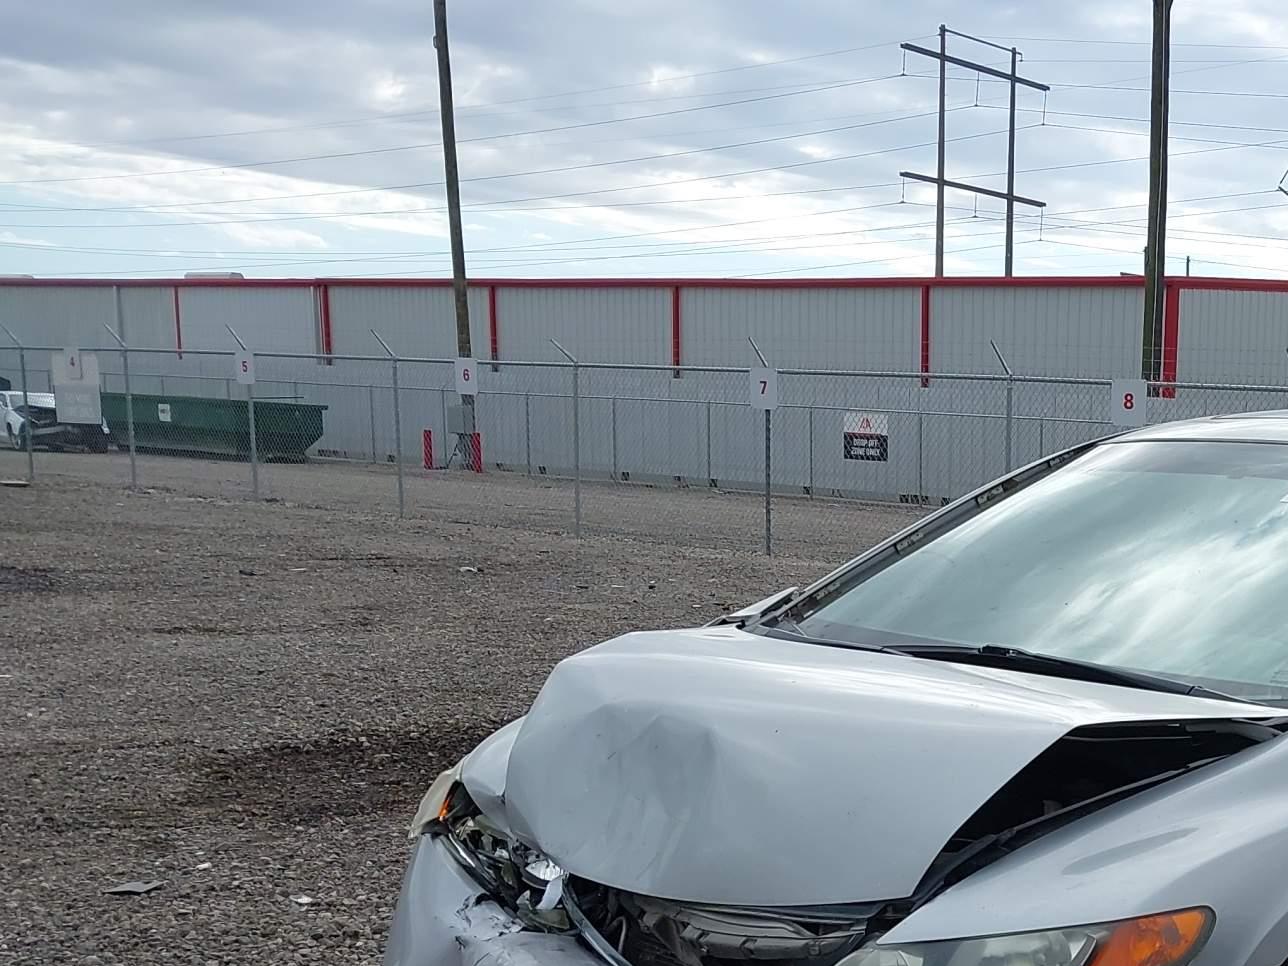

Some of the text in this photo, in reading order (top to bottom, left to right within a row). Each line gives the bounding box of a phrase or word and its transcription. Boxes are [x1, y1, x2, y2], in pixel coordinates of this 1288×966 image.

[241, 360, 248, 373] 5
[463, 368, 470, 381] 6
[759, 380, 767, 395] 7
[1123, 393, 1134, 410] 8
